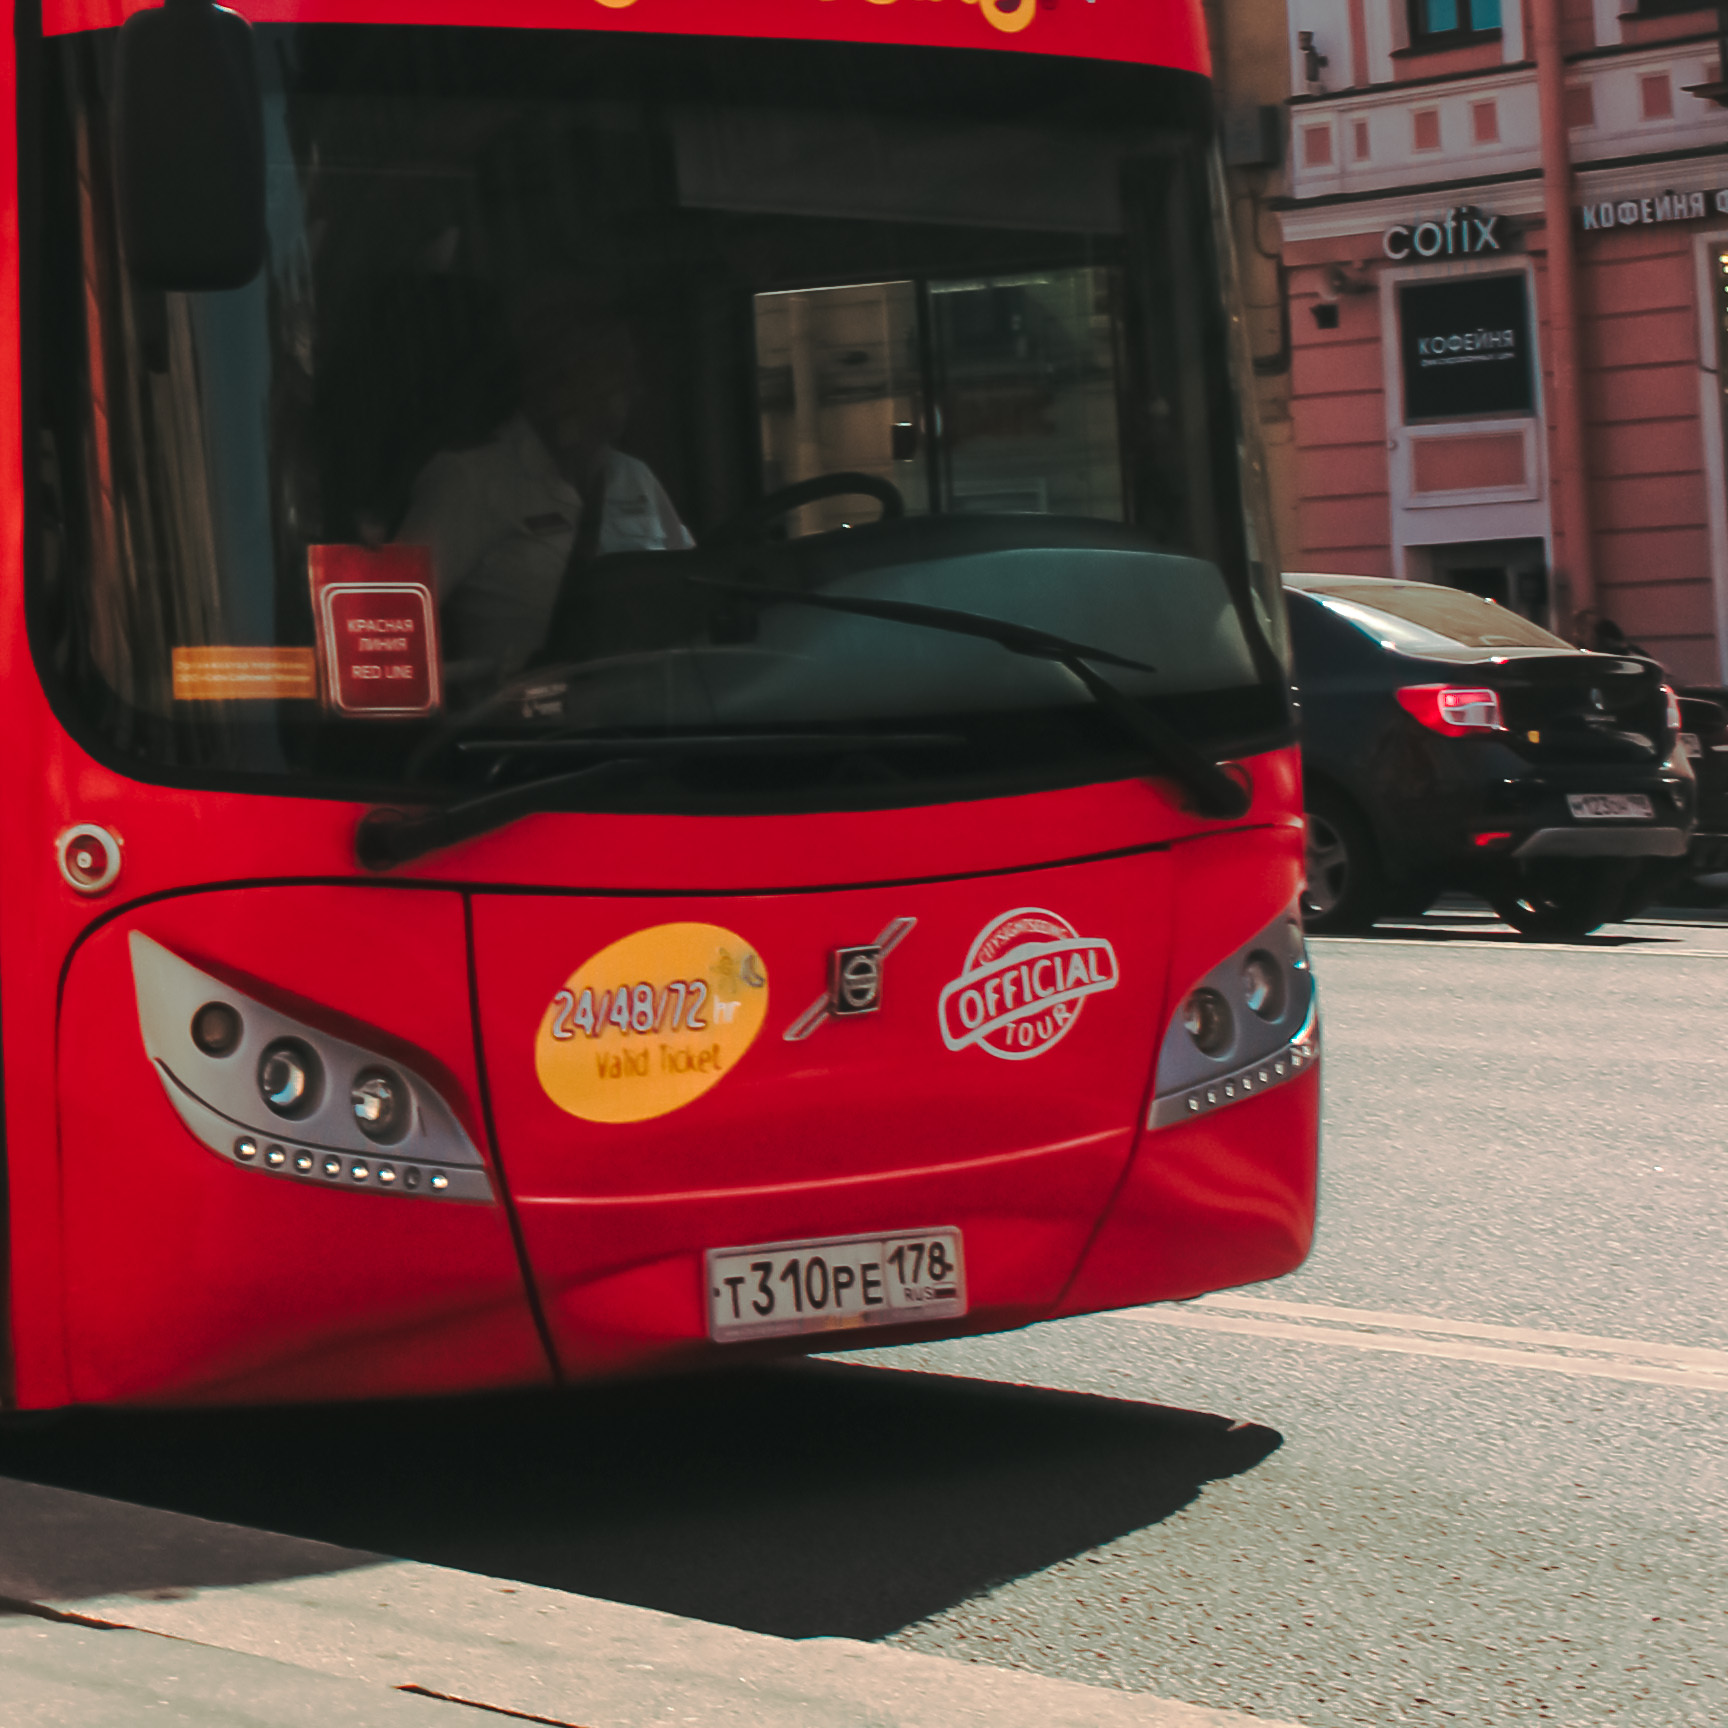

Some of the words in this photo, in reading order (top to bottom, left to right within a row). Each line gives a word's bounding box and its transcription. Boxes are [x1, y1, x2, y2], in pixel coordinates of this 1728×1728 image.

[1583, 190, 1706, 230] КОФЕЙНЯ
[1382, 207, 1501, 260] cofix
[1417, 328, 1515, 355] КОФЕЙНЯ
[351, 664, 381, 680] RED
[384, 664, 415, 680] LINE
[959, 949, 1108, 1029] OFFICIAL
[1005, 1003, 1073, 1047] TOUR
[659, 1043, 722, 1075] Ticket
[888, 1240, 947, 1286] 178
[904, 1287, 934, 1302] RUS
